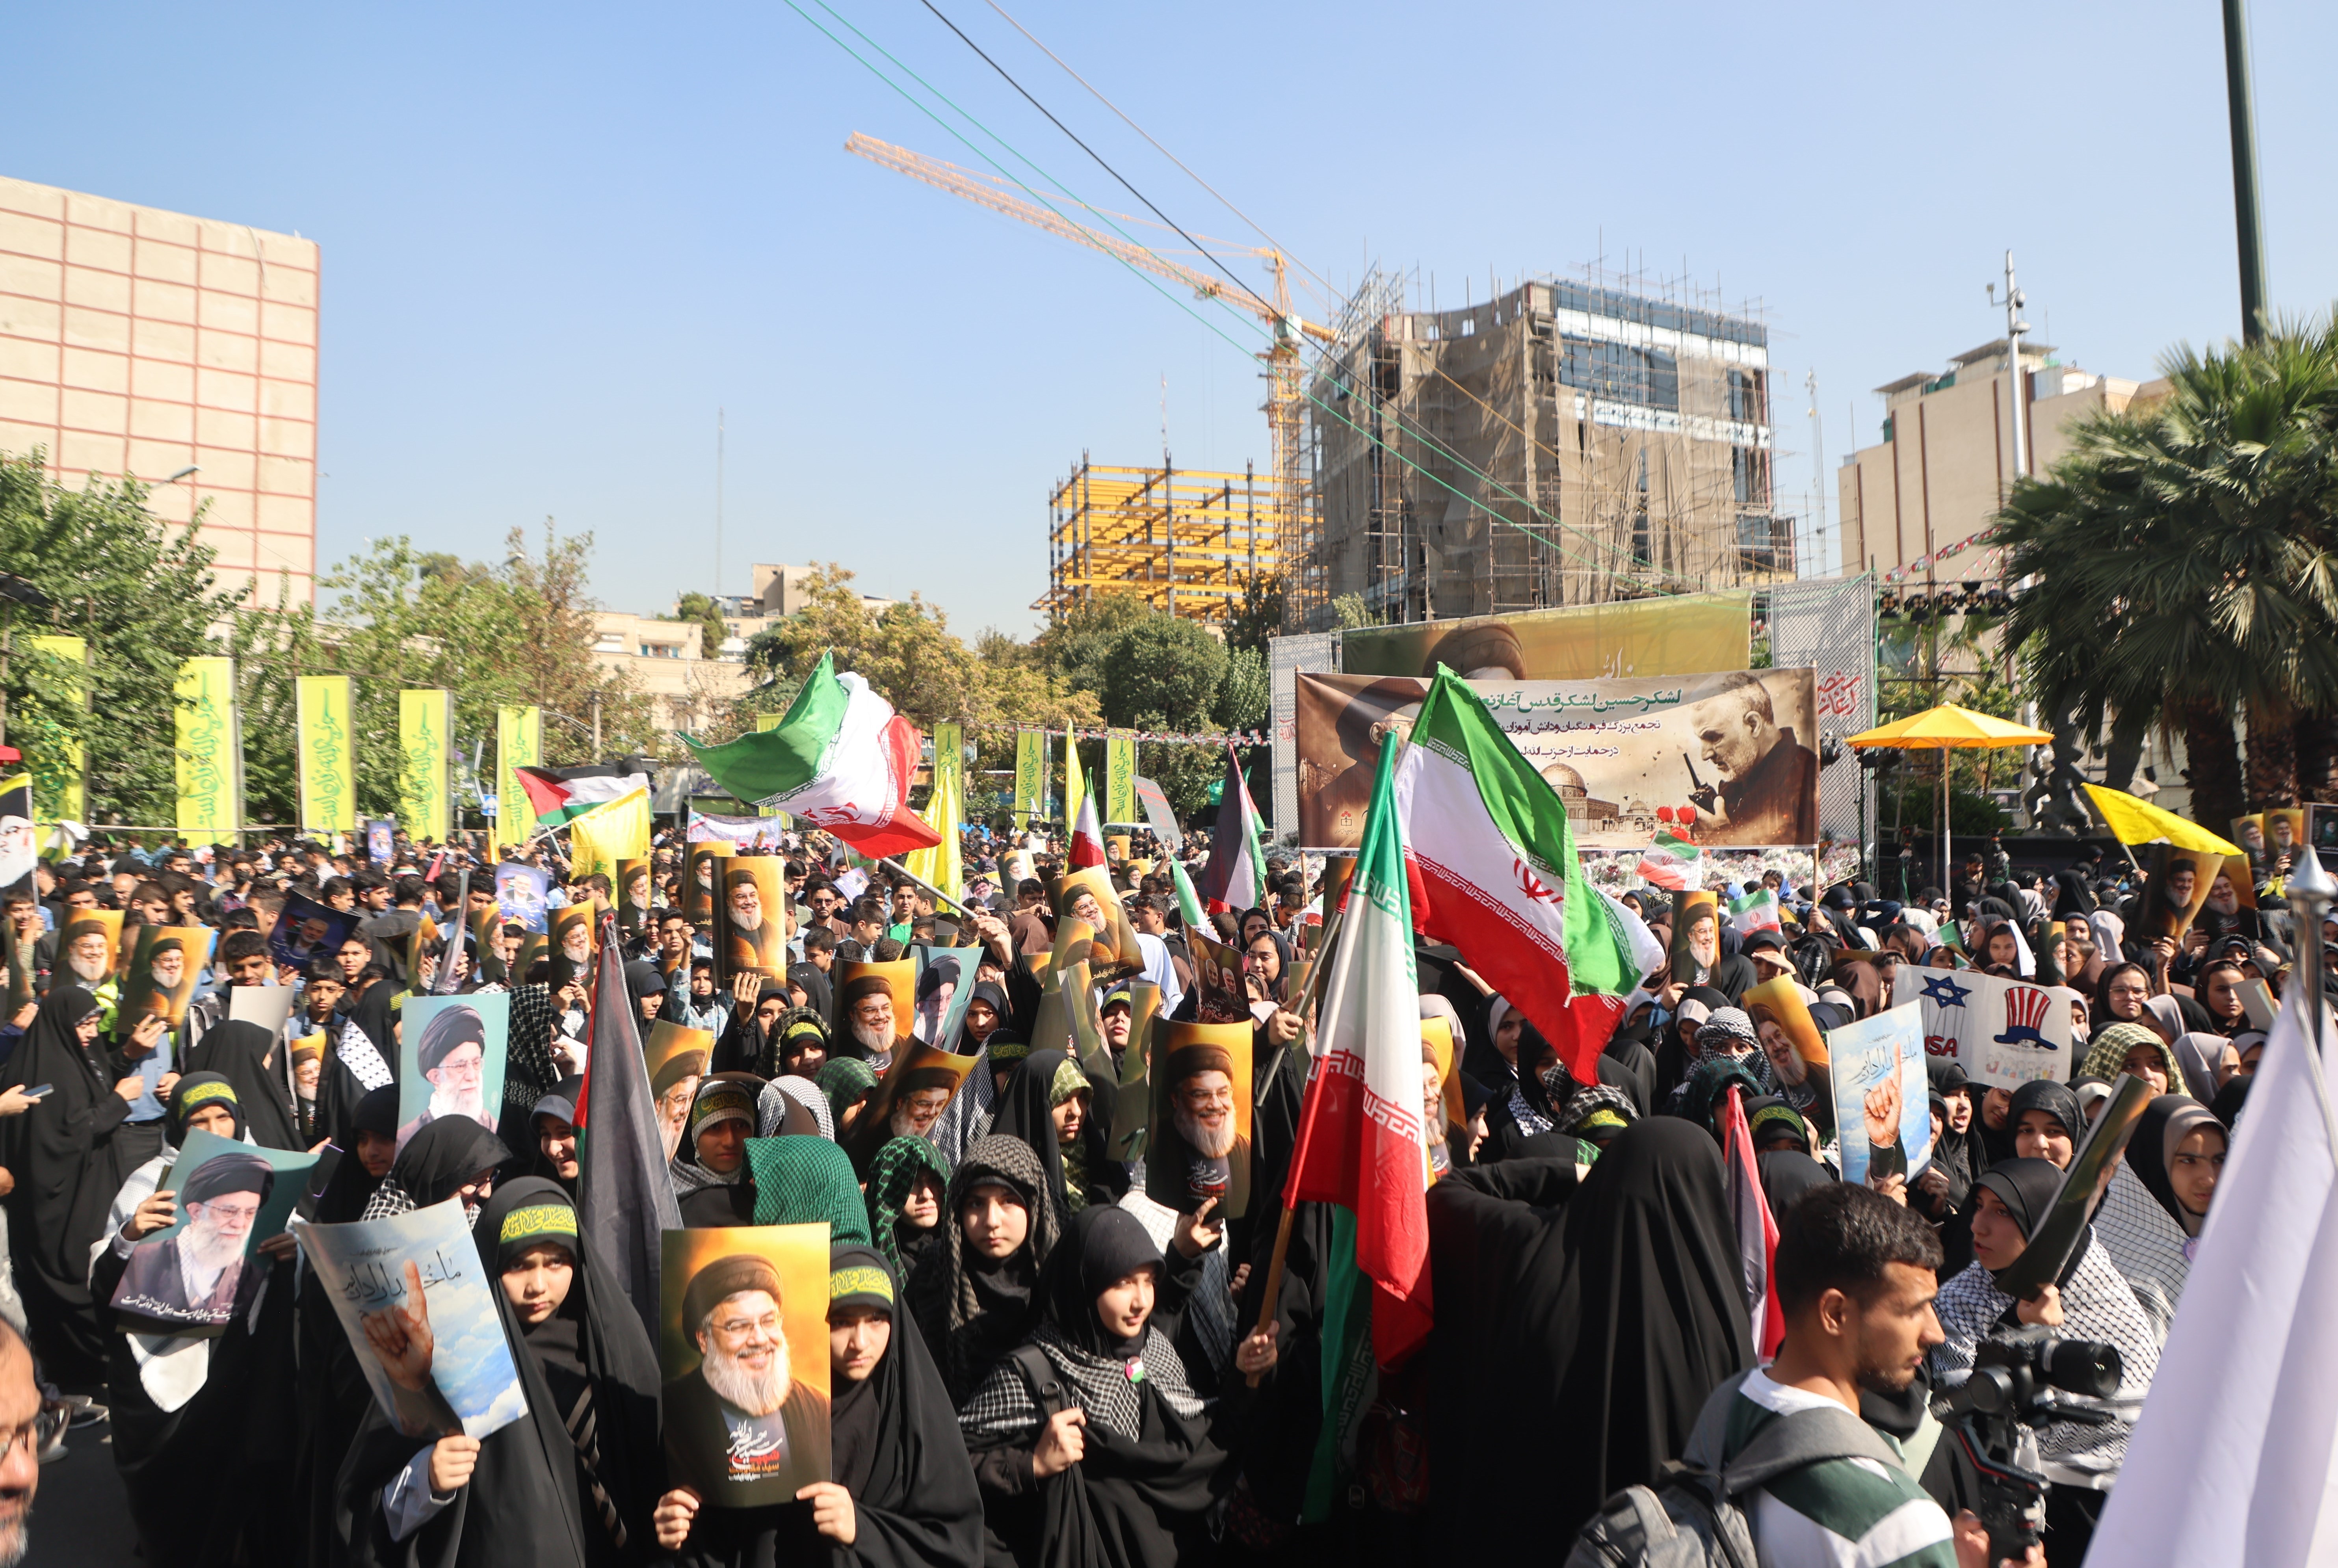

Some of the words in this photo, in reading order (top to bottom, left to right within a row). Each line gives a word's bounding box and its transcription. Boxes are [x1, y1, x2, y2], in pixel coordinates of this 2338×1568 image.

[1492, 691, 1524, 710] آغاز
[1518, 693, 1561, 713] قدس
[1554, 692, 1597, 713] لشکر
[1594, 694, 1646, 712] حسین
[1640, 688, 1682, 711] لشکر
[1559, 720, 1607, 734] فرهنگیان
[1607, 720, 1631, 733] بزرگ
[1631, 720, 1661, 734] تجمع
[1527, 744, 1541, 756] الله
[1541, 747, 1567, 759] حزب
[1567, 745, 1574, 757] از
[1574, 745, 1609, 757] حمایت
[1608, 746, 1619, 756] در
